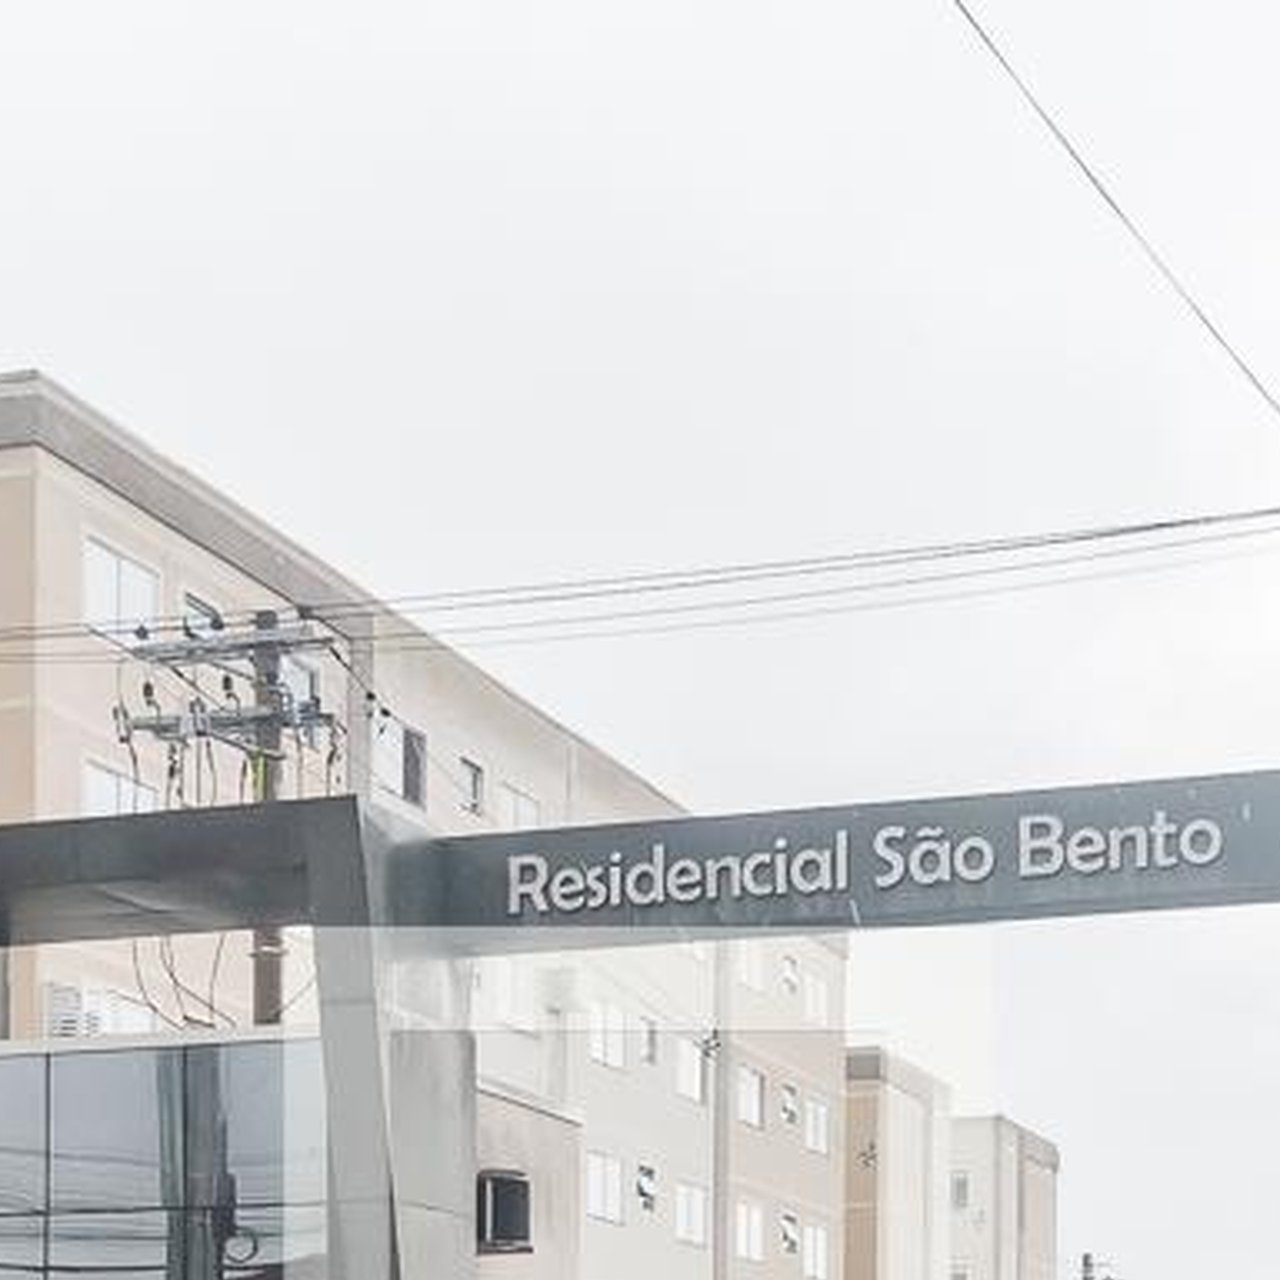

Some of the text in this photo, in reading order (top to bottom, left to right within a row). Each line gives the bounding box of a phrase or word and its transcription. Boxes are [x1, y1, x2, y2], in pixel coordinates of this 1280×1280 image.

[508, 809, 1223, 915] Residencial São Bento
